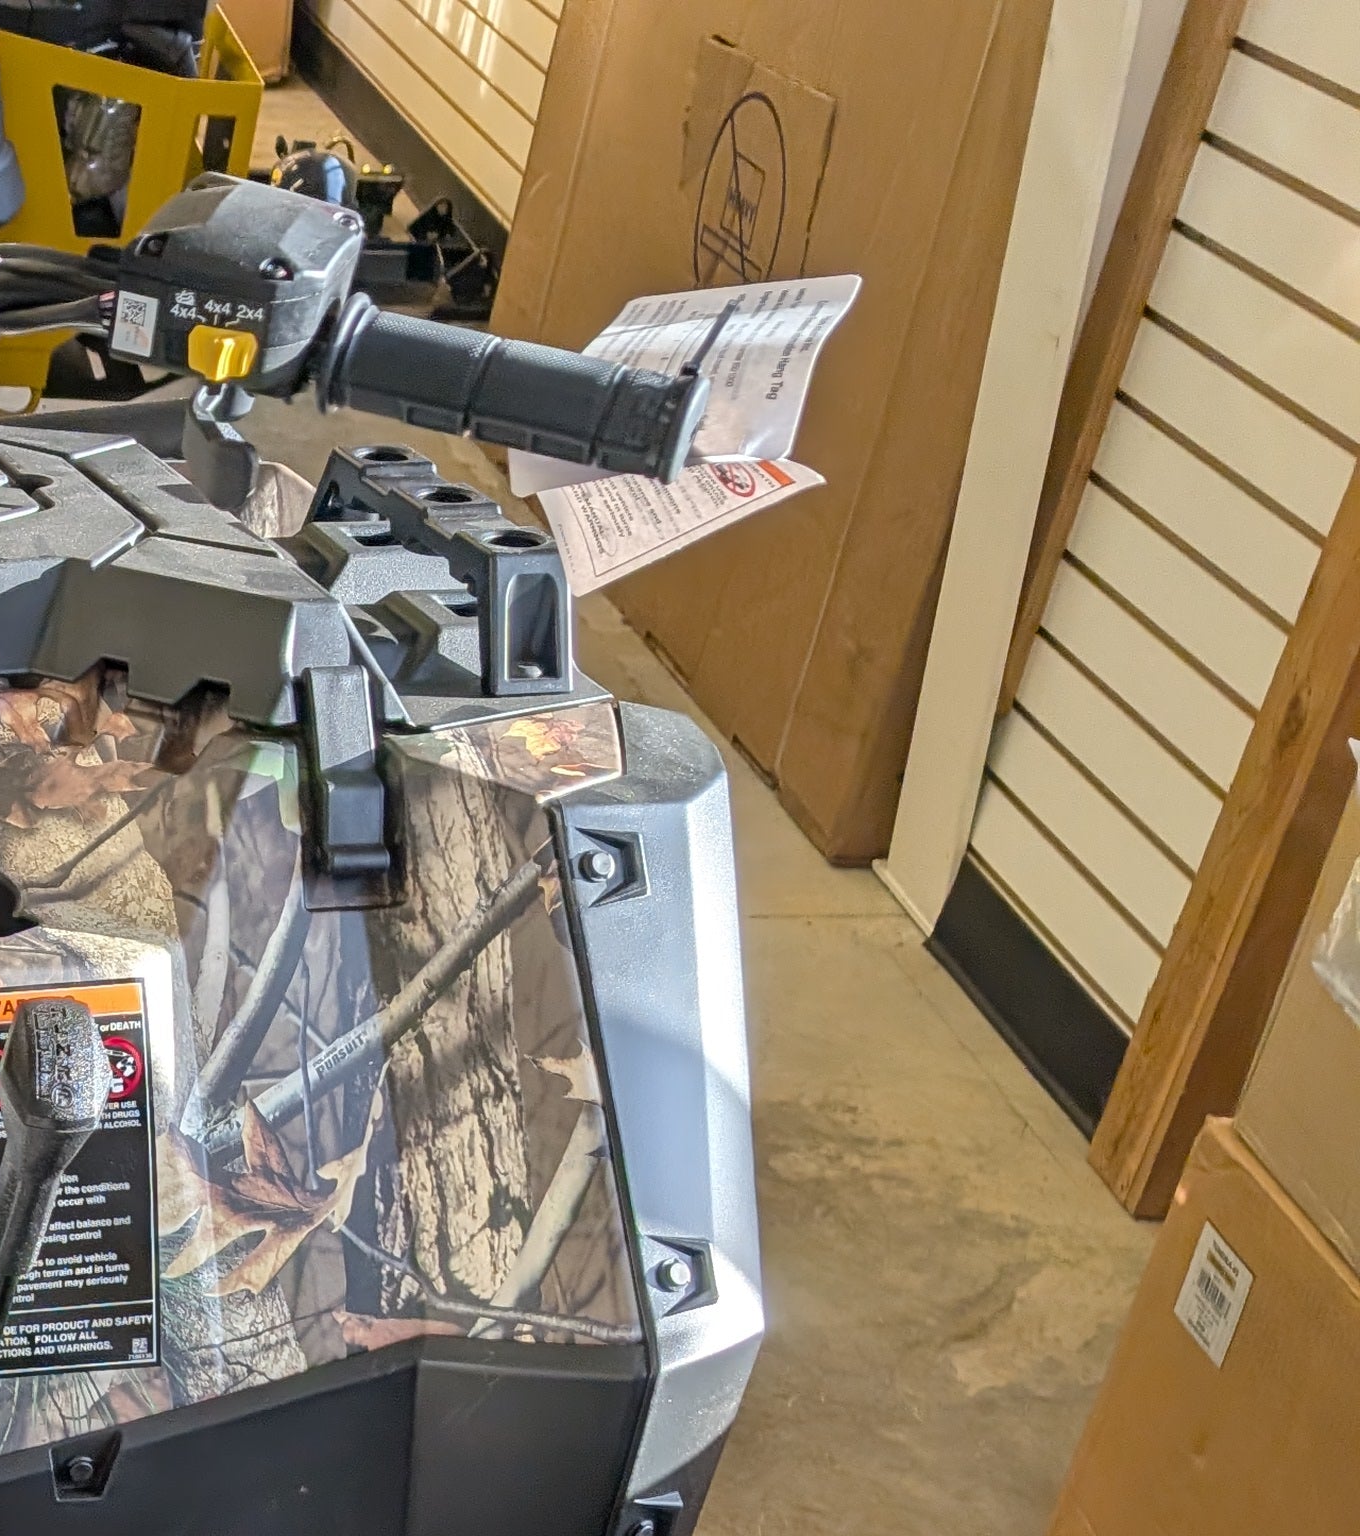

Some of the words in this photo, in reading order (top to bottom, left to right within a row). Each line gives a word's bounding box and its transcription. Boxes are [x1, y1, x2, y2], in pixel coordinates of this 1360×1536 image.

[170, 304, 197, 320] 4x4
[205, 299, 231, 314] 4x4
[236, 305, 265, 320] 2x4
[765, 381, 784, 400] Tag
[110, 1020, 141, 1031] DEATH
[315, 1034, 365, 1080] PURSUIT
[121, 1100, 137, 1109] USE
[112, 1110, 140, 1119] DRUGS
[103, 1119, 142, 1129] ALCOHOL
[64, 1185, 80, 1195] the
[81, 1181, 131, 1194] conditions
[57, 1197, 84, 1207] occur
[85, 1195, 107, 1205] with
[49, 1220, 75, 1231] affect
[76, 1217, 112, 1229] balance
[113, 1215, 131, 1226] and
[69, 1229, 101, 1240] control
[45, 1257, 56, 1266] to
[57, 1254, 83, 1265] avoid
[84, 1251, 118, 1263] vehicle
[42, 1267, 73, 1278] terrain
[74, 1265, 93, 1276] and
[94, 1264, 104, 1274] in
[105, 1262, 131, 1272] turns
[64, 1278, 85, 1289] may
[86, 1275, 128, 1287] seriously
[19, 1324, 41, 1335] FOR
[42, 1320, 90, 1333] PRODUCT
[91, 1318, 113, 1329] AND
[114, 1314, 153, 1327] SAFETY
[34, 1333, 77, 1344] FOLLOW
[78, 1331, 98, 1342] ALL
[33, 1344, 55, 1356] AND
[56, 1340, 114, 1354] WARNINGS.
